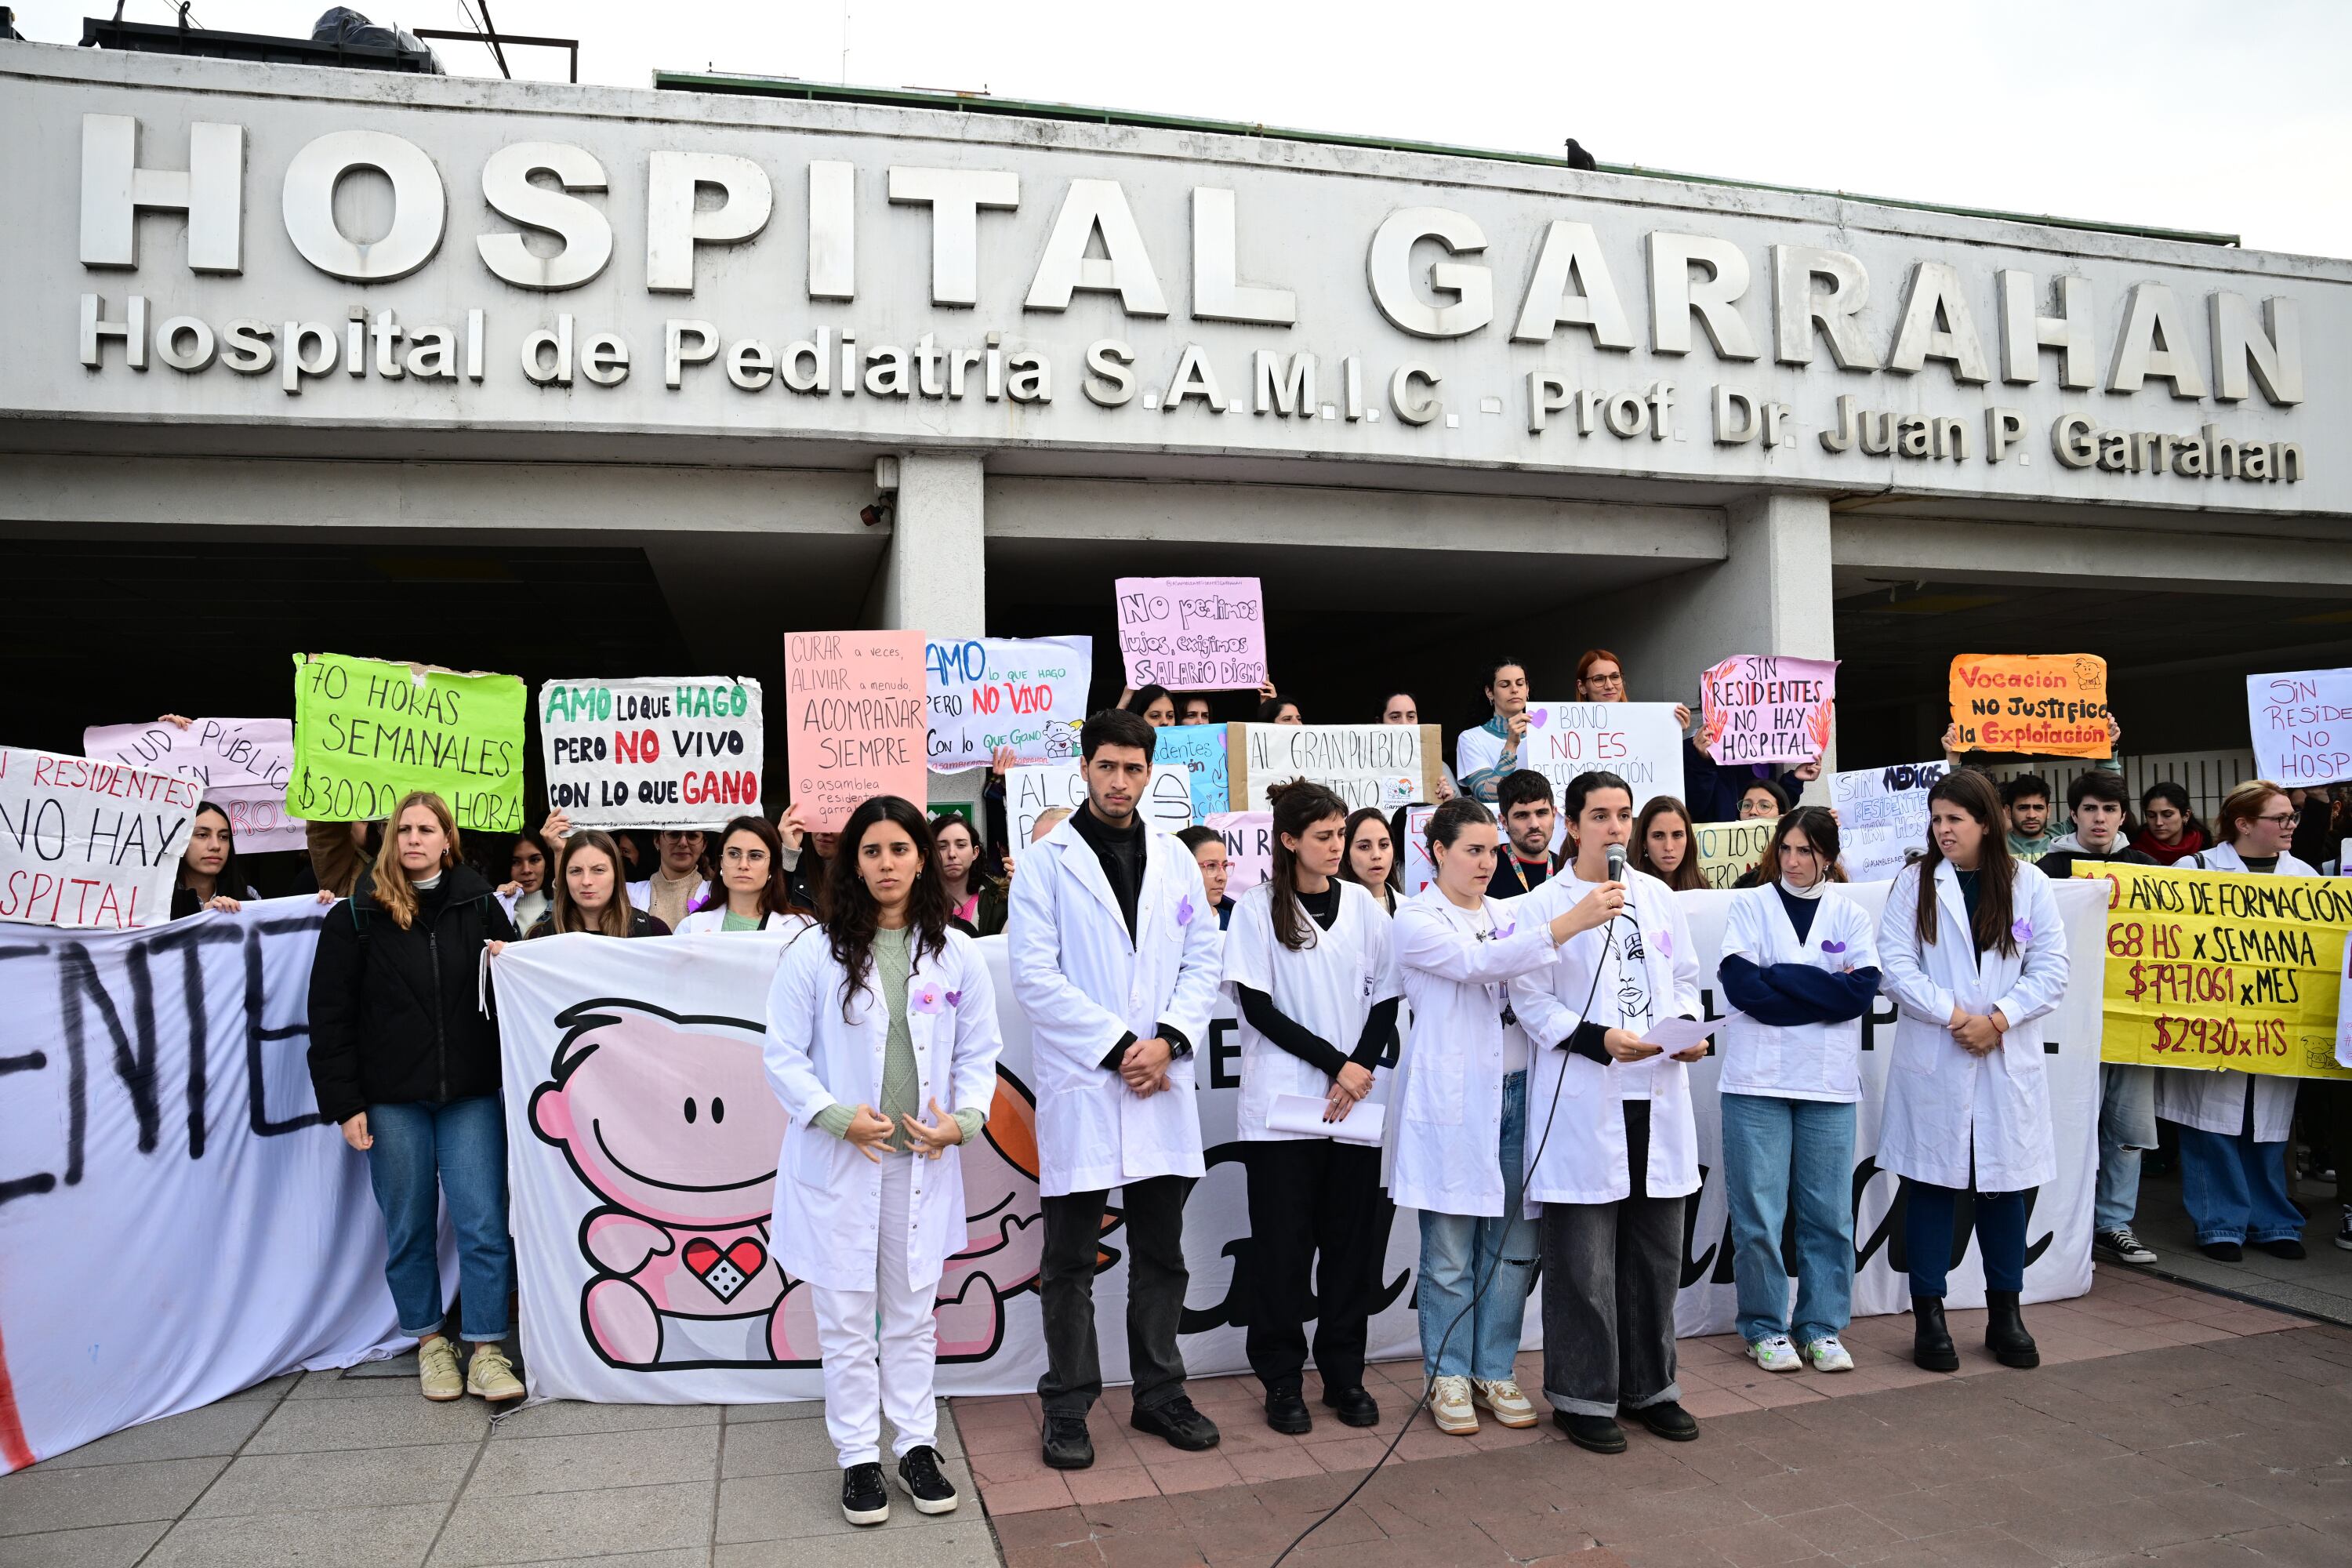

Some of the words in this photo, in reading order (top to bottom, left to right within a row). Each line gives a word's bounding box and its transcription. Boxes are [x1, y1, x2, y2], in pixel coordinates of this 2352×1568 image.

[79, 113, 1296, 327] HOSPITAL
[1366, 206, 2303, 407] GARRAHAN
[80, 292, 485, 394] Hospital
[521, 314, 630, 388] de
[665, 318, 1053, 404] Pediatria
[1819, 394, 1970, 461] Juan
[2051, 412, 2305, 482] Garrahan
[1178, 595, 1258, 630] pedimos
[791, 635, 843, 663] CURAR
[855, 648, 862, 658] a
[926, 641, 986, 686] AMO
[1007, 670, 1028, 683] QUE
[1038, 668, 1066, 681] HAGO
[1176, 635, 1249, 659] exigimos
[791, 668, 851, 694] ALIVIAR
[859, 681, 867, 691] a
[1745, 657, 1777, 681] SIN
[303, 662, 347, 699] 70
[368, 674, 461, 726] HORAS
[545, 685, 612, 724] AMO
[676, 684, 748, 718] HAGO
[972, 683, 1000, 716] NO
[1003, 682, 1053, 715] VIVO
[1712, 680, 1824, 707] RESIDENTES
[1971, 698, 2000, 716] NO
[804, 696, 925, 733] ACOMPAÑAR
[1559, 704, 1608, 730] BONO
[1734, 710, 1757, 731] NO
[1774, 707, 1806, 730] HAY
[322, 713, 514, 778] SEMANALES
[554, 736, 607, 765] PERO
[615, 728, 660, 764] NO
[672, 729, 744, 758] VIVO
[983, 734, 1007, 754] QUE
[1251, 732, 1274, 770] AL
[1550, 731, 1581, 760] NO
[1598, 732, 1627, 759] ES
[1722, 732, 1813, 760] HOSPITAL
[1959, 724, 1976, 743] la
[2292, 731, 2330, 750] NO
[818, 737, 910, 769] SIEMPRE
[2281, 753, 2350, 779] HOSP
[34, 756, 199, 809] RESIDENTES
[298, 766, 397, 819] $3000
[456, 791, 522, 829] HORA
[550, 782, 590, 808] CON
[601, 780, 629, 808] LO
[637, 780, 679, 804] QUE
[682, 770, 758, 805] GANO
[1021, 773, 1060, 808] AL
[87, 808, 187, 867] HAY
[1729, 827, 1748, 857] LO
[1860, 818, 1886, 844] HAY
[0, 869, 147, 929] SPITAL
[2129, 875, 2185, 913] AÑOS
[2188, 881, 2216, 915] DE
[2107, 923, 2144, 957] 68
[2152, 924, 2183, 959] HS
[2125, 960, 2234, 1003] $797.061
